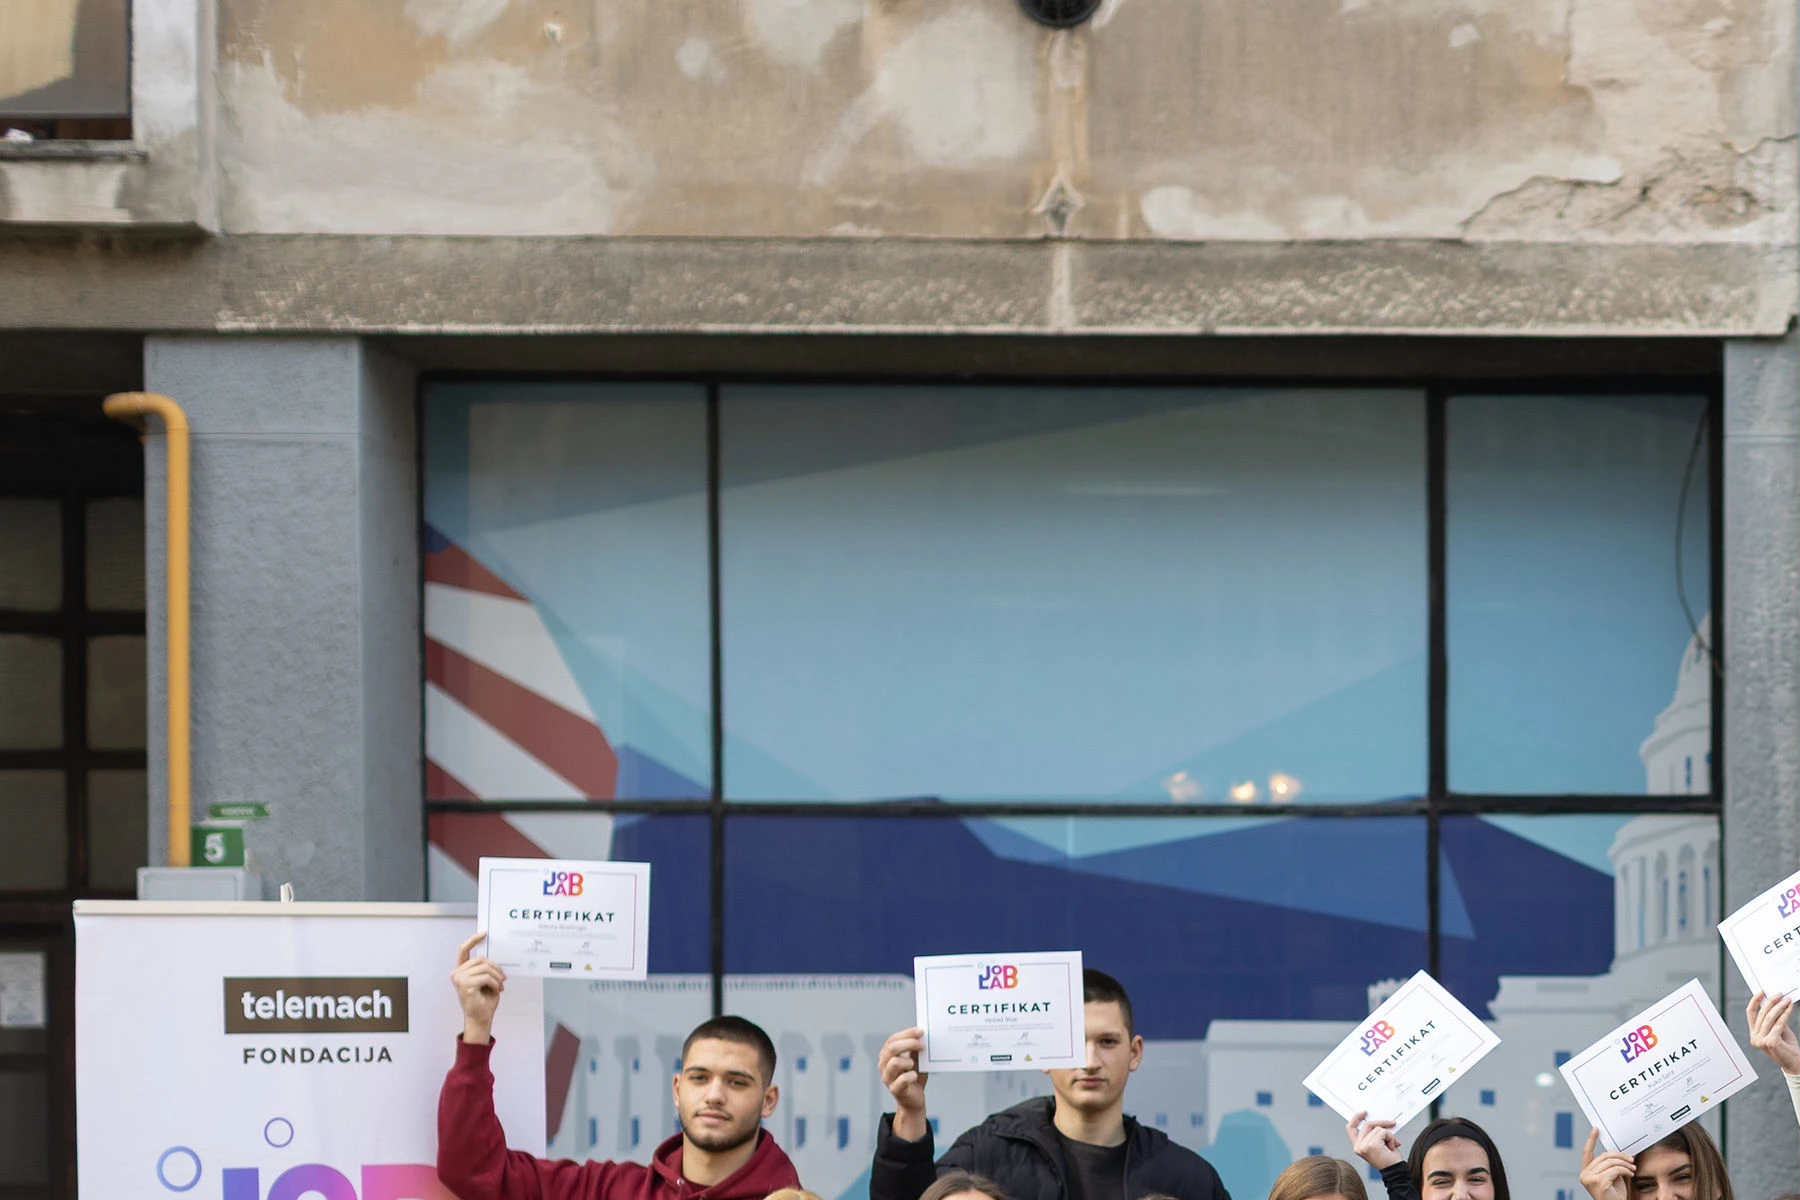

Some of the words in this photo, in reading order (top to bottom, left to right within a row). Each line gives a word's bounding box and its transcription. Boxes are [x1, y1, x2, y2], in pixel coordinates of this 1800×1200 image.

[204, 832, 225, 864] 5
[543, 880, 582, 896] LAB
[509, 909, 615, 923] CERTIFIKAT
[978, 973, 1017, 989] LAB
[241, 989, 392, 1019] telemach
[948, 1002, 1051, 1015] CERTIFIKAT
[243, 1046, 393, 1064] FONDACIJA
[1358, 1020, 1436, 1091] CERTIFIKAT
[1360, 1024, 1396, 1057] LAB
[1621, 1030, 1657, 1062] LAB
[1609, 1039, 1699, 1100] CERTIFIKAT
